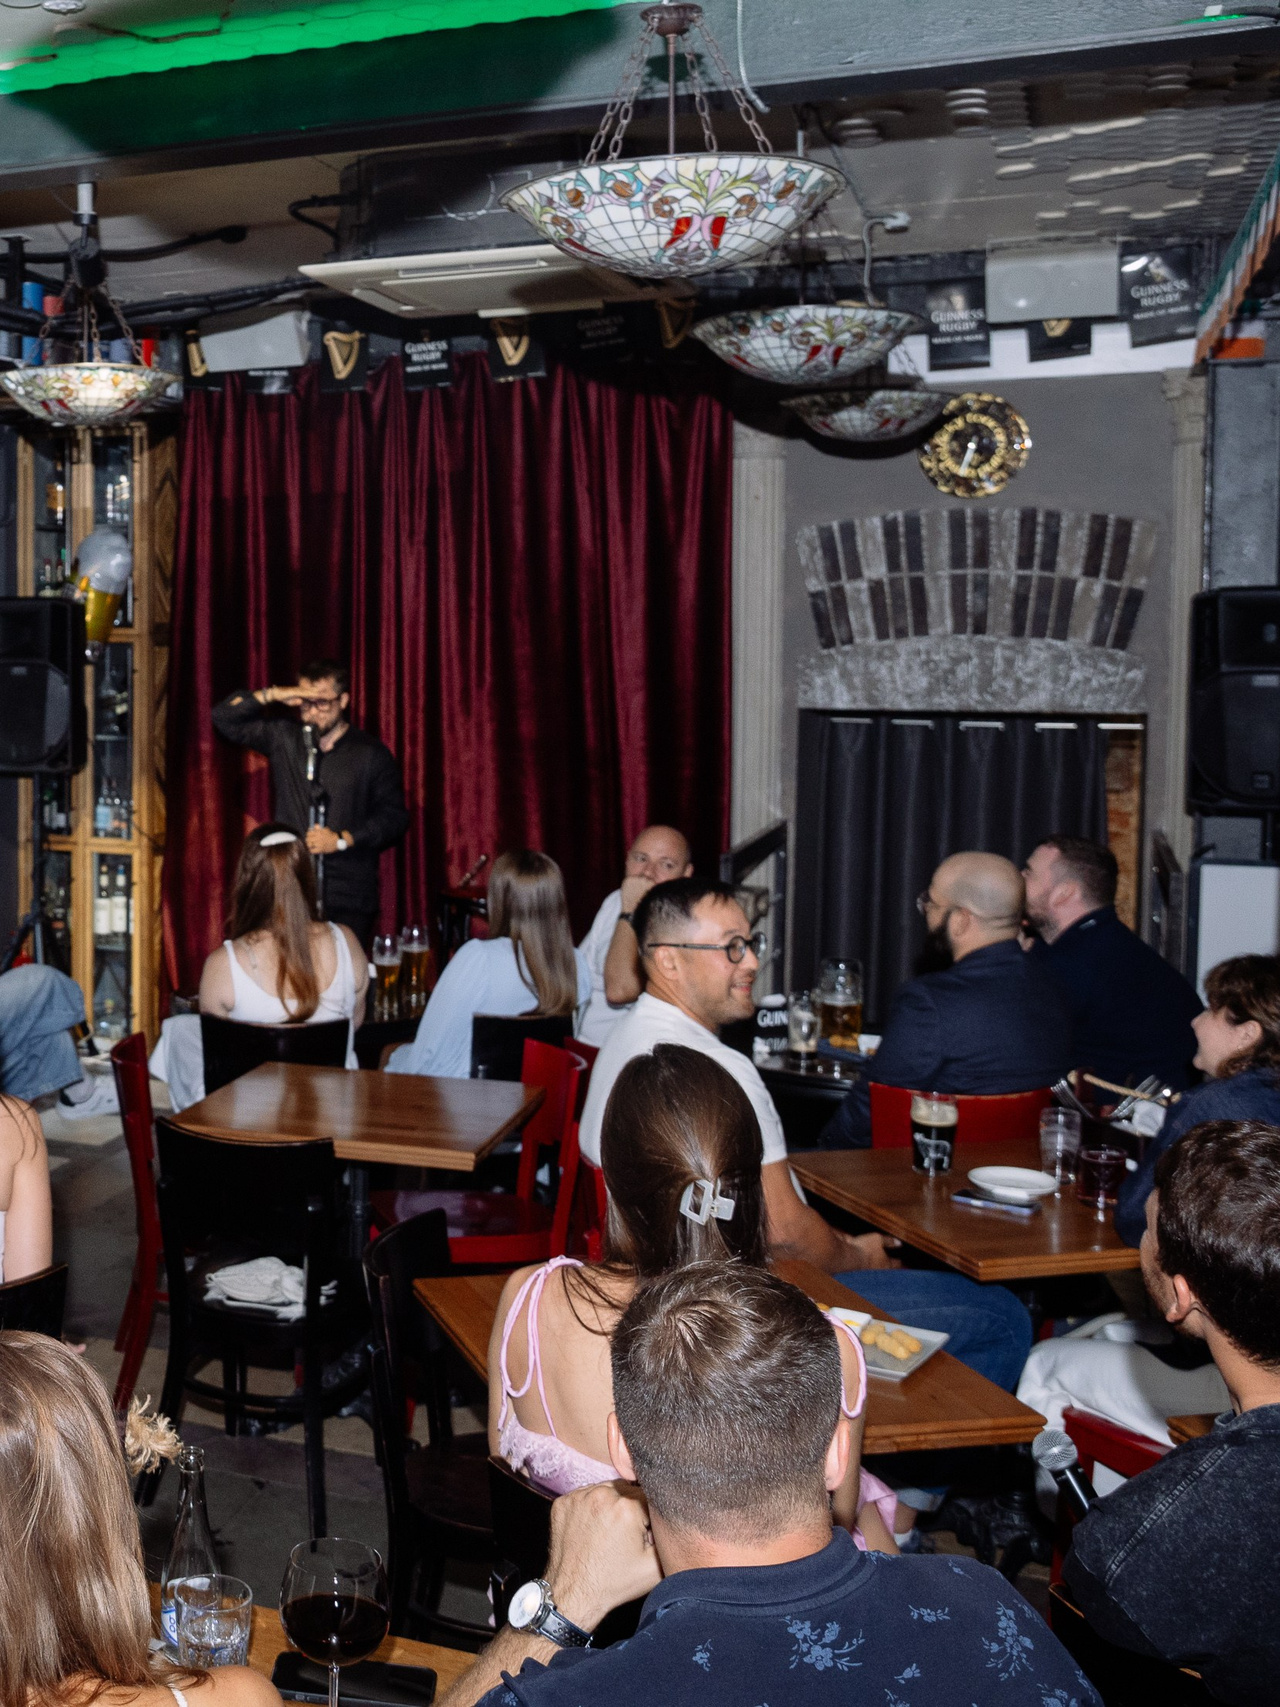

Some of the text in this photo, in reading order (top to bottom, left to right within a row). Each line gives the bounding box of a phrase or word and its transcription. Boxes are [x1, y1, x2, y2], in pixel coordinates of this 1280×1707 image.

[1130, 279, 1189, 299] GUINNESS
[1141, 291, 1181, 307] RUGBY
[931, 308, 985, 324] GUINNESS
[939, 320, 978, 332] RUGBY
[404, 340, 449, 354] GUINNESS
[757, 1009, 789, 1028] GUIN
